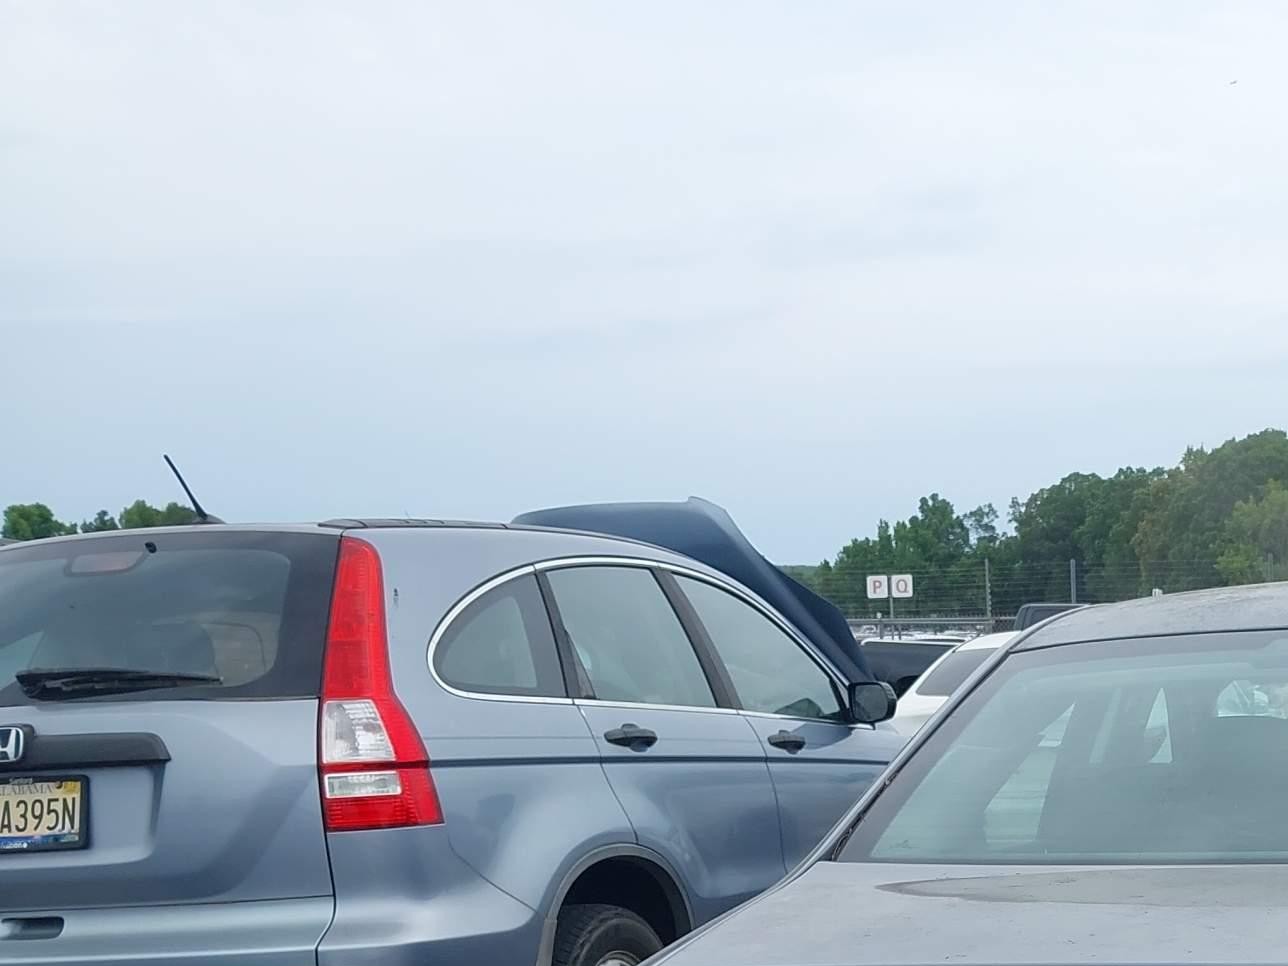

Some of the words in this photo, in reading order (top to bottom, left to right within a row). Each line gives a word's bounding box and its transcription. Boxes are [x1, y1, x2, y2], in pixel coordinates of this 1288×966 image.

[872, 580, 882, 595] P
[896, 579, 909, 593] Q
[0, 783, 53, 797] LABAMA
[0, 797, 76, 833] A395N
